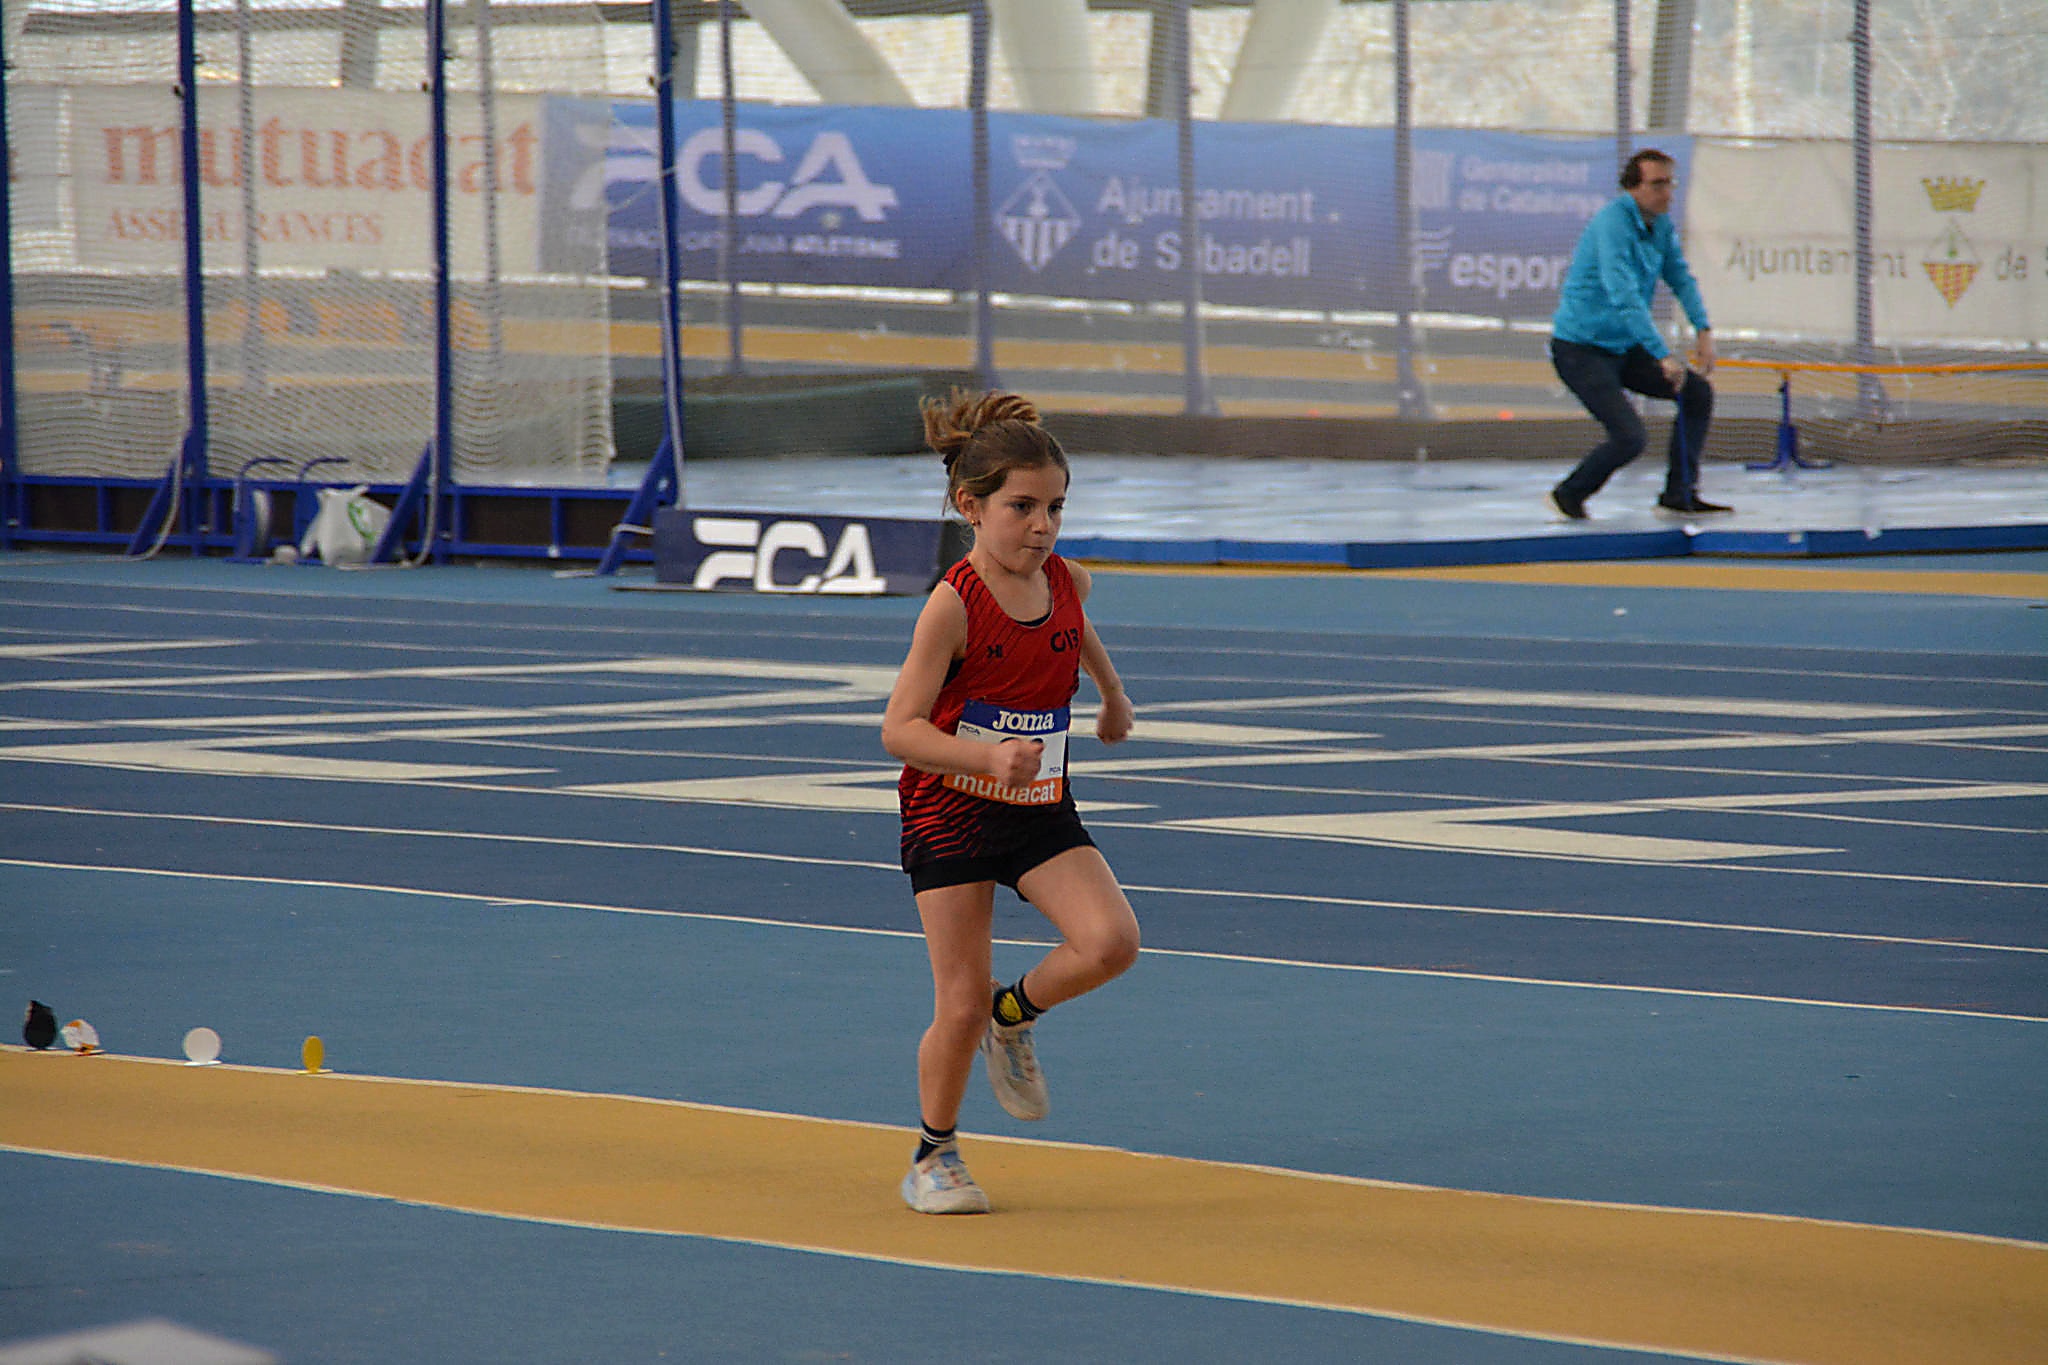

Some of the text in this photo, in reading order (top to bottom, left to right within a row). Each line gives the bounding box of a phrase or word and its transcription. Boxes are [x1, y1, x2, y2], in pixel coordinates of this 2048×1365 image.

[101, 116, 538, 195] mutuacat
[570, 121, 898, 222] FCA
[1098, 176, 1314, 225] Ajunament
[1093, 230, 1312, 277] de Sbadell
[692, 517, 888, 594] FCA
[953, 774, 1057, 803] mutuacat
